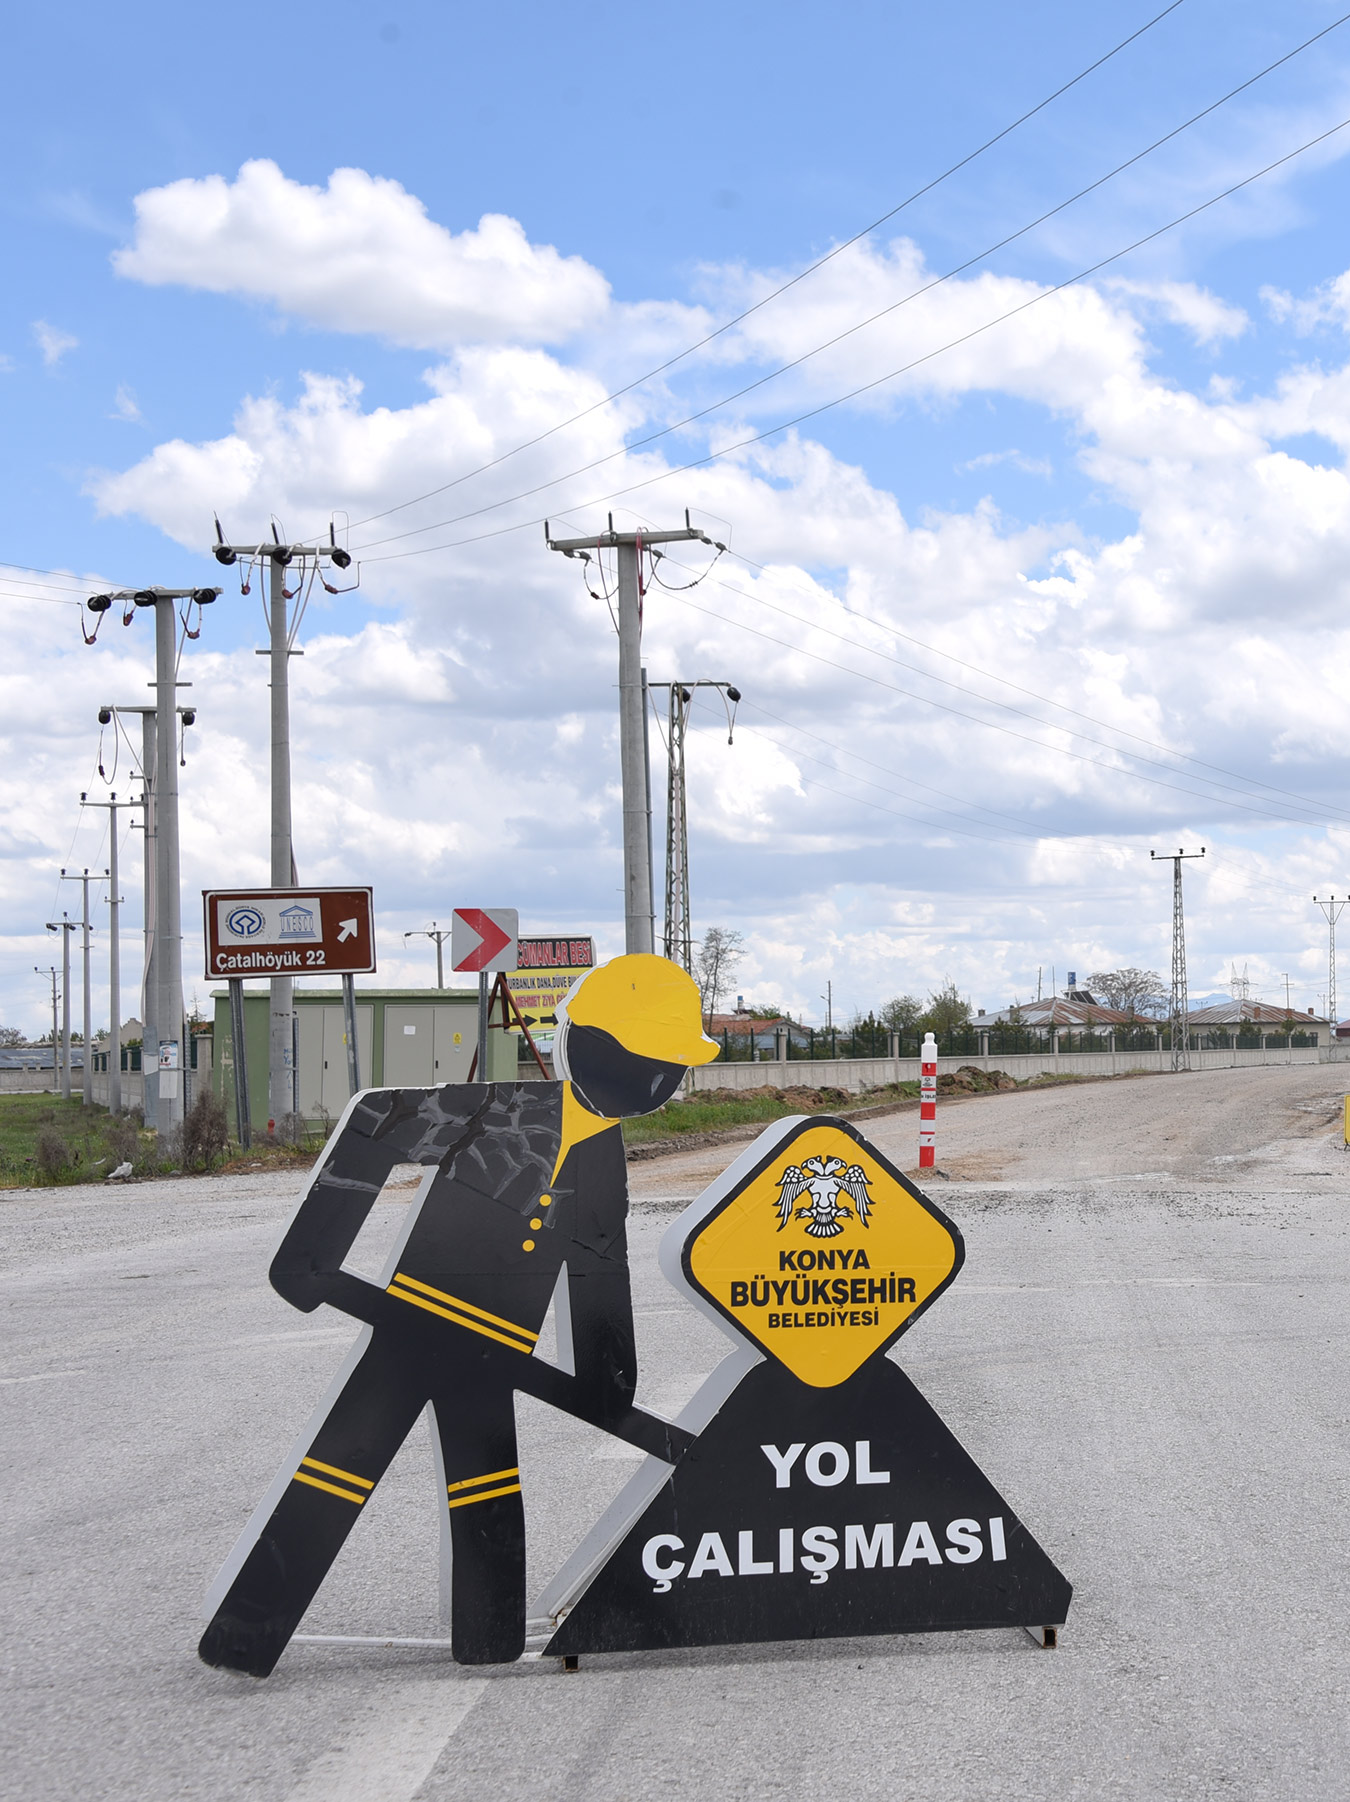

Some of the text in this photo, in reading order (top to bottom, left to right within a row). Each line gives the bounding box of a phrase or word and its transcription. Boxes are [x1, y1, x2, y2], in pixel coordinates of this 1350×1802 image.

[280, 916, 314, 932] UNESCO
[216, 950, 326, 972] Çatalhöyük 22
[507, 977, 537, 990] URBANLIK
[779, 1249, 870, 1271] KONYA
[730, 1272, 917, 1309] BÜYÜKŞEHİR
[768, 1307, 879, 1329] BELEDİYESİ
[760, 1440, 891, 1488] YOL
[641, 1516, 1007, 1593] ÇALIŞMASI
